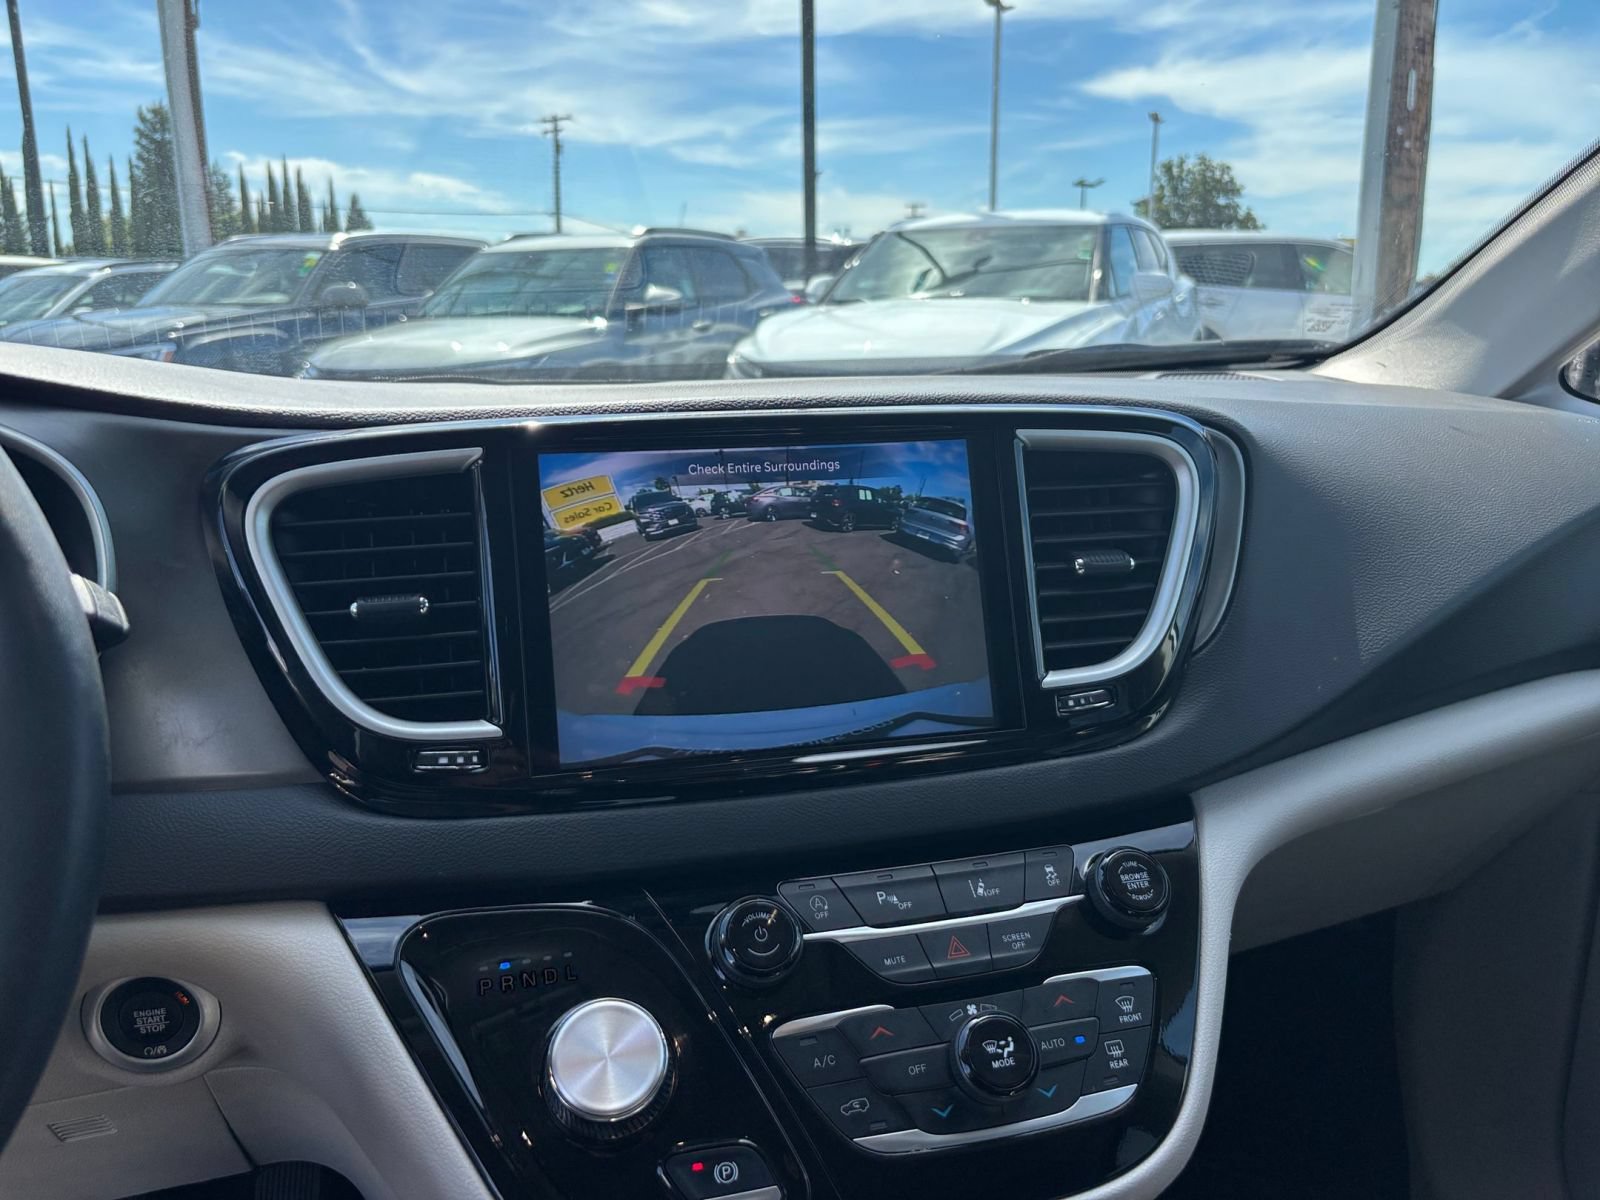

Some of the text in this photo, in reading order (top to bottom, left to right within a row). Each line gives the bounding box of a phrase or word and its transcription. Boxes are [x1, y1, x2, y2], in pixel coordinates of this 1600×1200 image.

[688, 459, 840, 476] Check Entire Surroundings
[1122, 861, 1139, 870] TUNE
[1047, 876, 1062, 887] OFF
[1120, 871, 1149, 883] BROWSE
[1126, 880, 1149, 890] ENTER
[986, 887, 1000, 896] OFF
[1130, 889, 1154, 901] SCROLL
[898, 900, 912, 910] OFF
[744, 912, 770, 923] VOLUME
[814, 909, 829, 918] OFF
[1002, 931, 1031, 943] SCREEN
[1012, 940, 1026, 950] OFF
[883, 955, 906, 966] MUTE
[134, 1008, 166, 1017] ENGINE
[1119, 1012, 1143, 1024] FRONT
[136, 1015, 166, 1025] START
[140, 1024, 166, 1034] STOP
[1041, 1037, 1065, 1050] AUTO
[814, 1055, 836, 1068] A/C
[991, 1057, 1015, 1069] MODE
[1109, 1058, 1129, 1069] REAR
[908, 1063, 927, 1075] OFF
